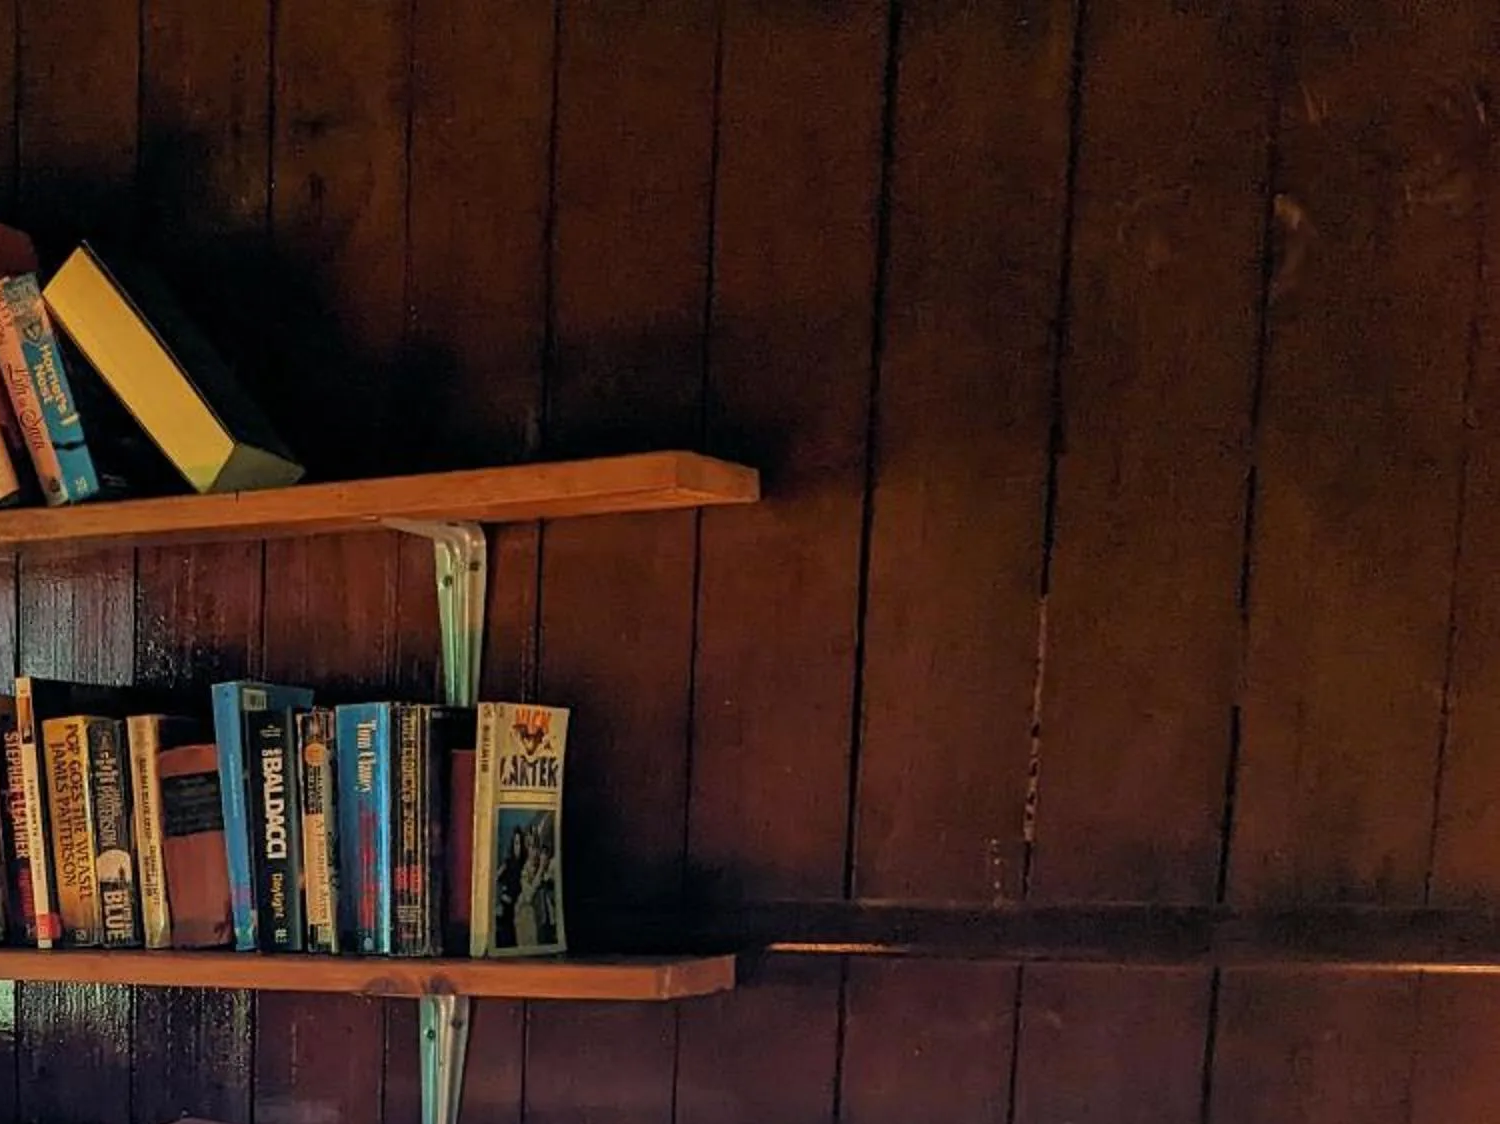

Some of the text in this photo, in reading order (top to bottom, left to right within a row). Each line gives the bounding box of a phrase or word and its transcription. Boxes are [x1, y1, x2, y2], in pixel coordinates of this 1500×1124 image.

[50, 741, 78, 888] JAMES PATTERSON
[64, 723, 93, 902] POP GOES THE WEASEL
[261, 755, 288, 860] BALDACCI
[103, 888, 127, 942] BLUE
